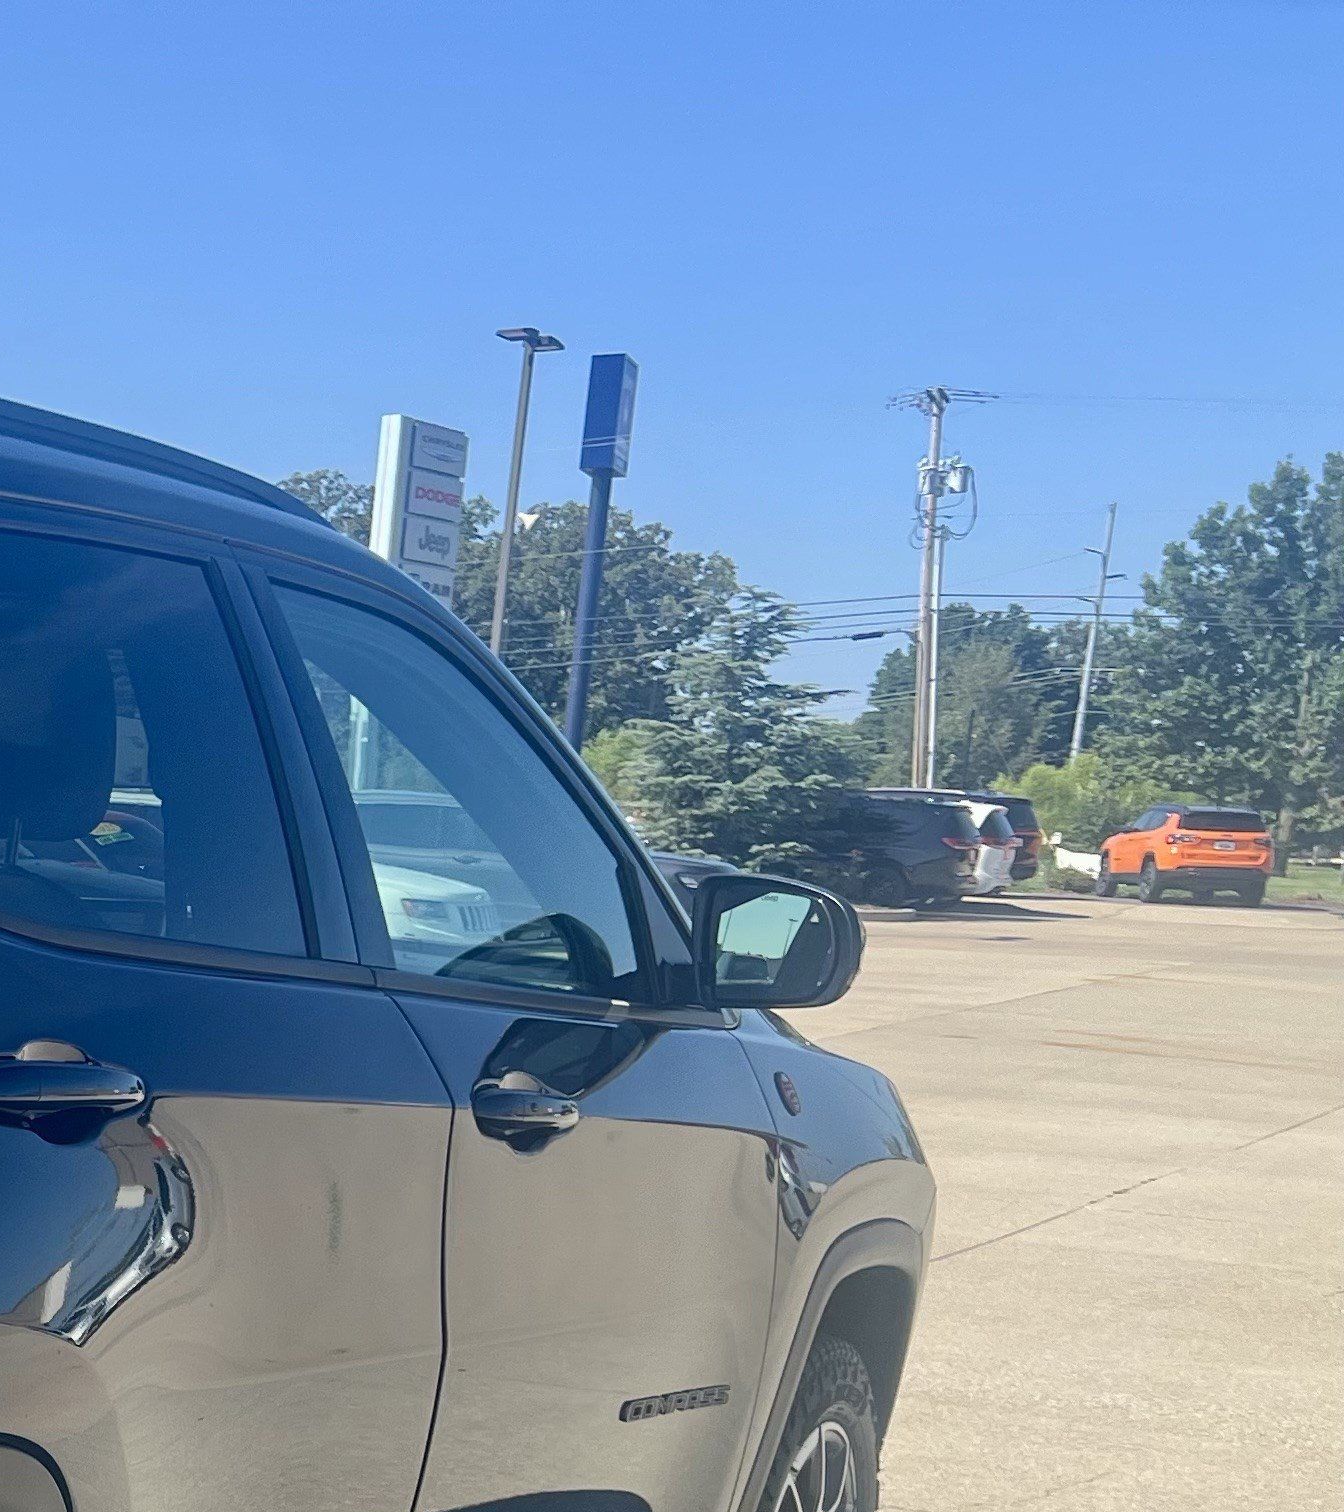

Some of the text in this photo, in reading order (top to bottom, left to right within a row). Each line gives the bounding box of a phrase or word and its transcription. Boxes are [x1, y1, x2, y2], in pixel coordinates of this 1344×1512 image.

[415, 487, 461, 508] DODGE
[418, 525, 451, 559] Jeep
[618, 1384, 732, 1423] COMPASS
